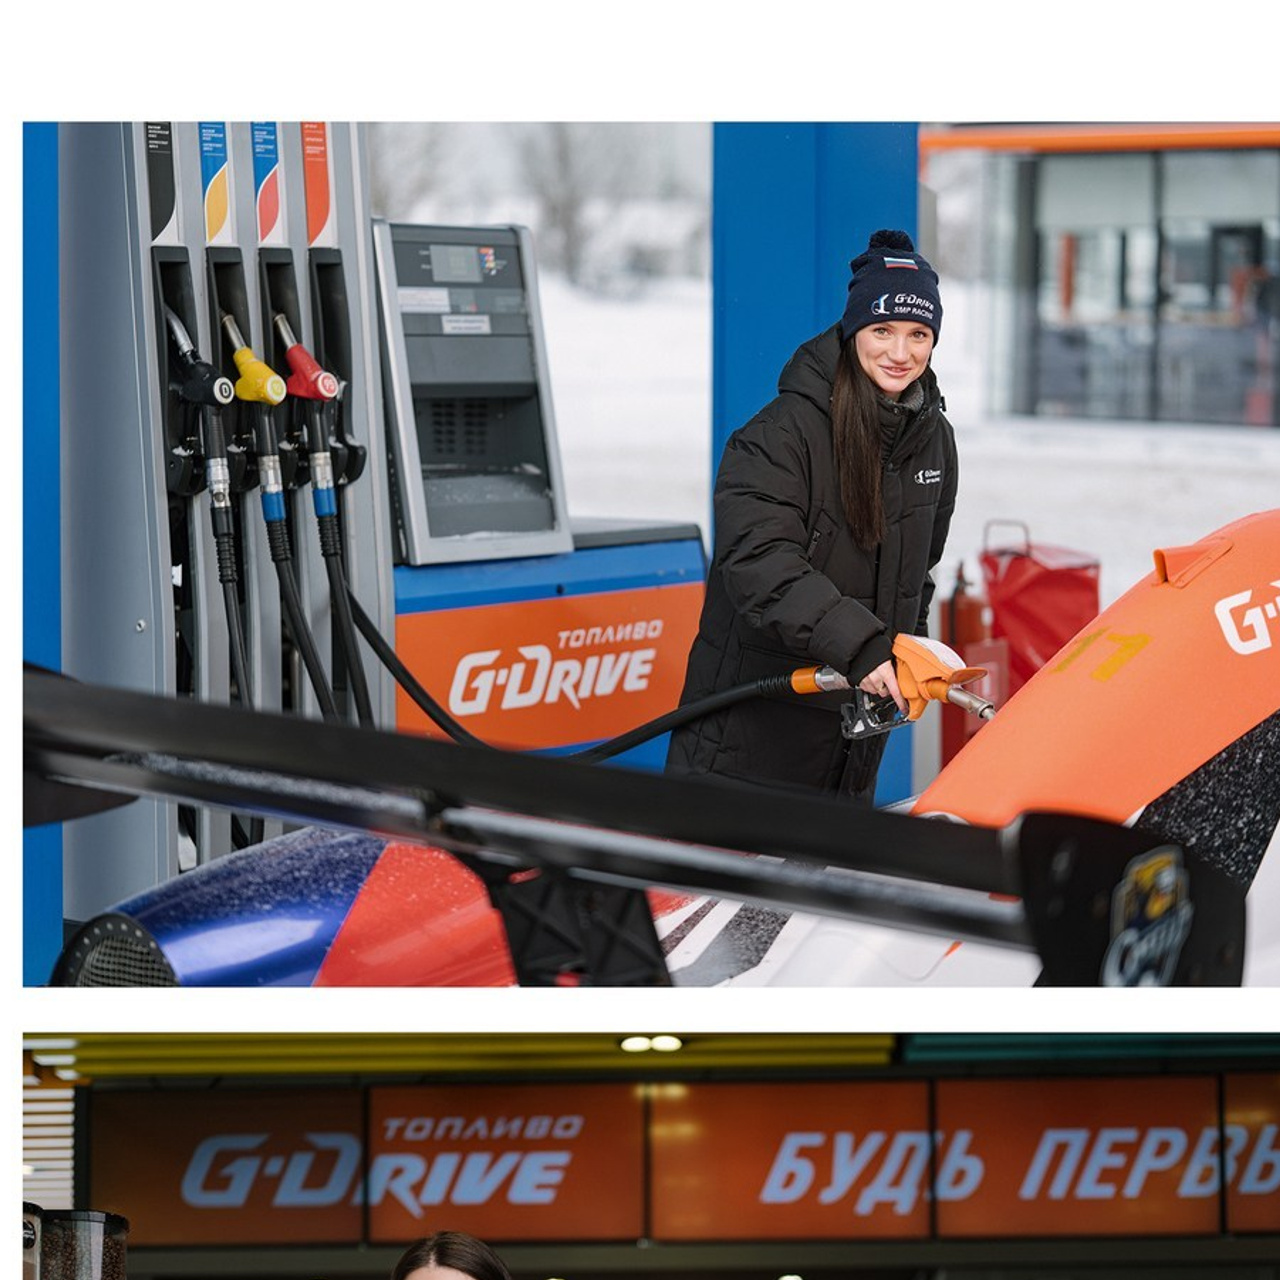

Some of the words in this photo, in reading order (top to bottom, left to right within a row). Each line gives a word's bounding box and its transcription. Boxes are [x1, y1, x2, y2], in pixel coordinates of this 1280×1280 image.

[893, 305, 911, 315] SMP
[911, 307, 934, 320] RACING
[557, 619, 663, 649] ТОПЛИВО
[448, 644, 657, 717] G-DRIVE
[382, 1114, 585, 1141] ТОПЛИВО
[180, 1132, 572, 1218] G-DRIVE
[758, 1131, 986, 1216] БУДЬ
